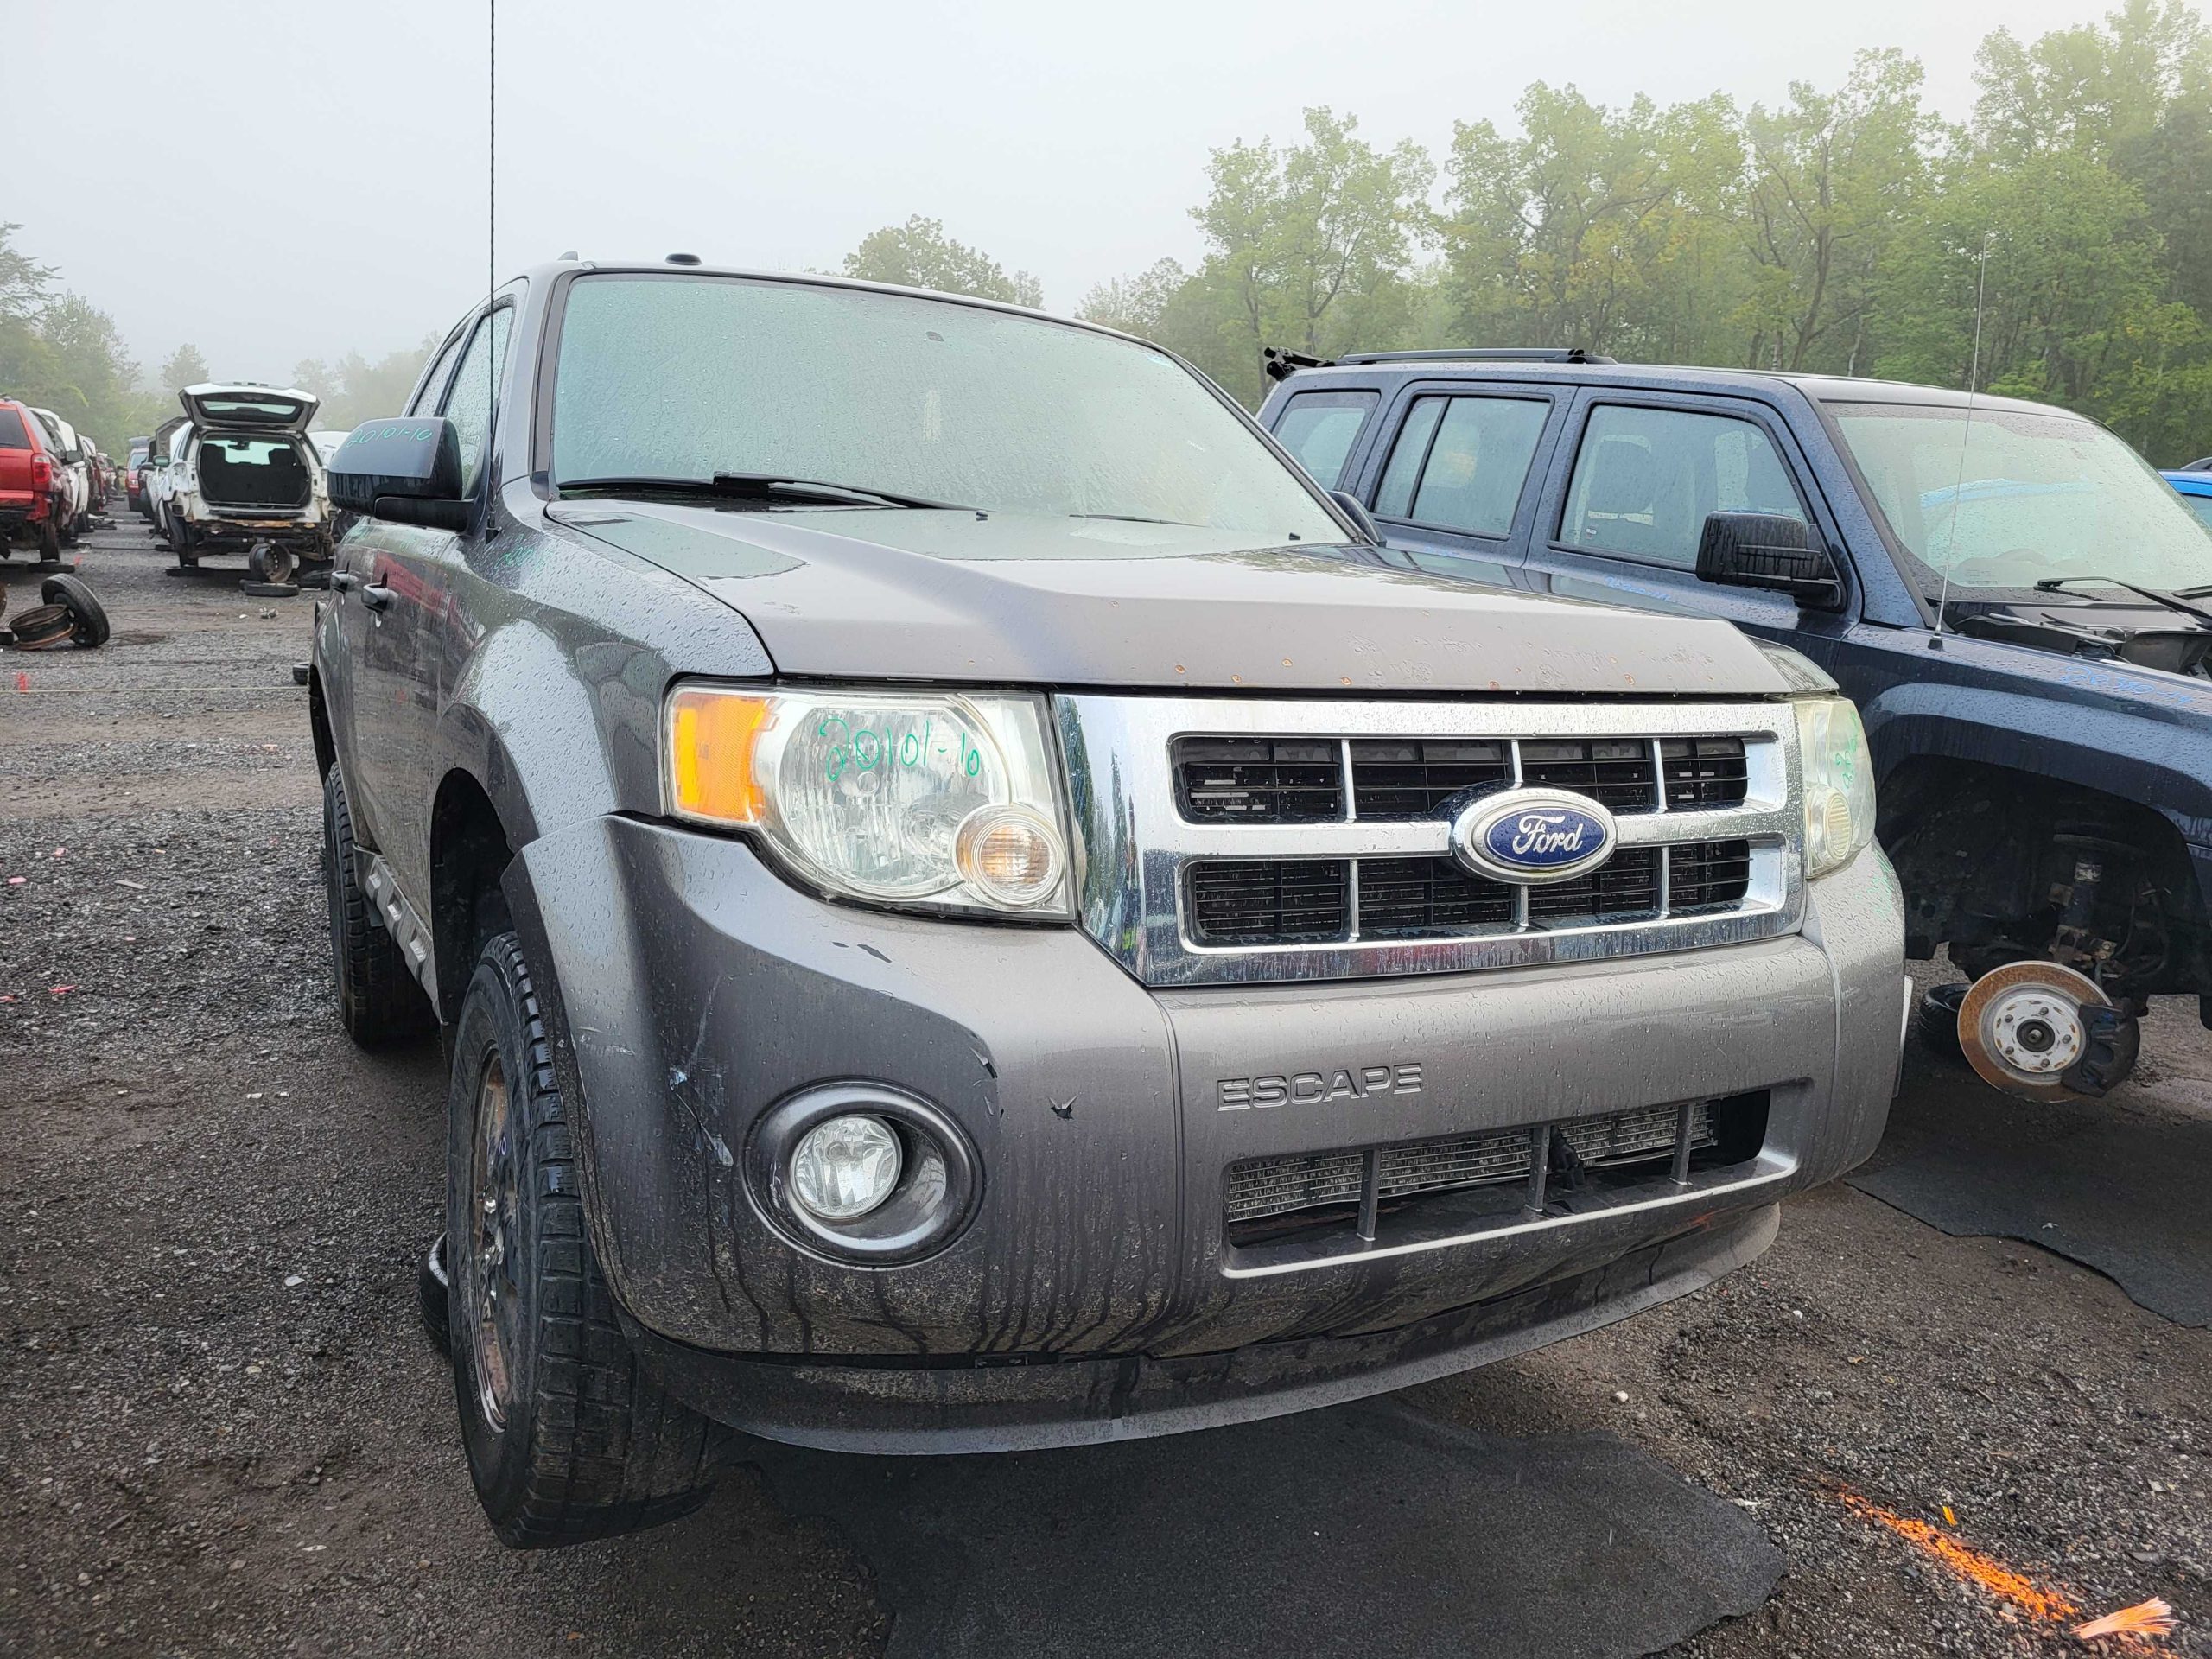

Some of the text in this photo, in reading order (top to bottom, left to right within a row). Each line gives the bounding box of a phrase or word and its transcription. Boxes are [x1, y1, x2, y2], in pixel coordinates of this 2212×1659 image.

[346, 427, 433, 448] 20101-10
[818, 718, 980, 782] 20101-10
[1512, 815, 1584, 855] Ford
[1217, 1062, 1421, 1112] ESCAPE
